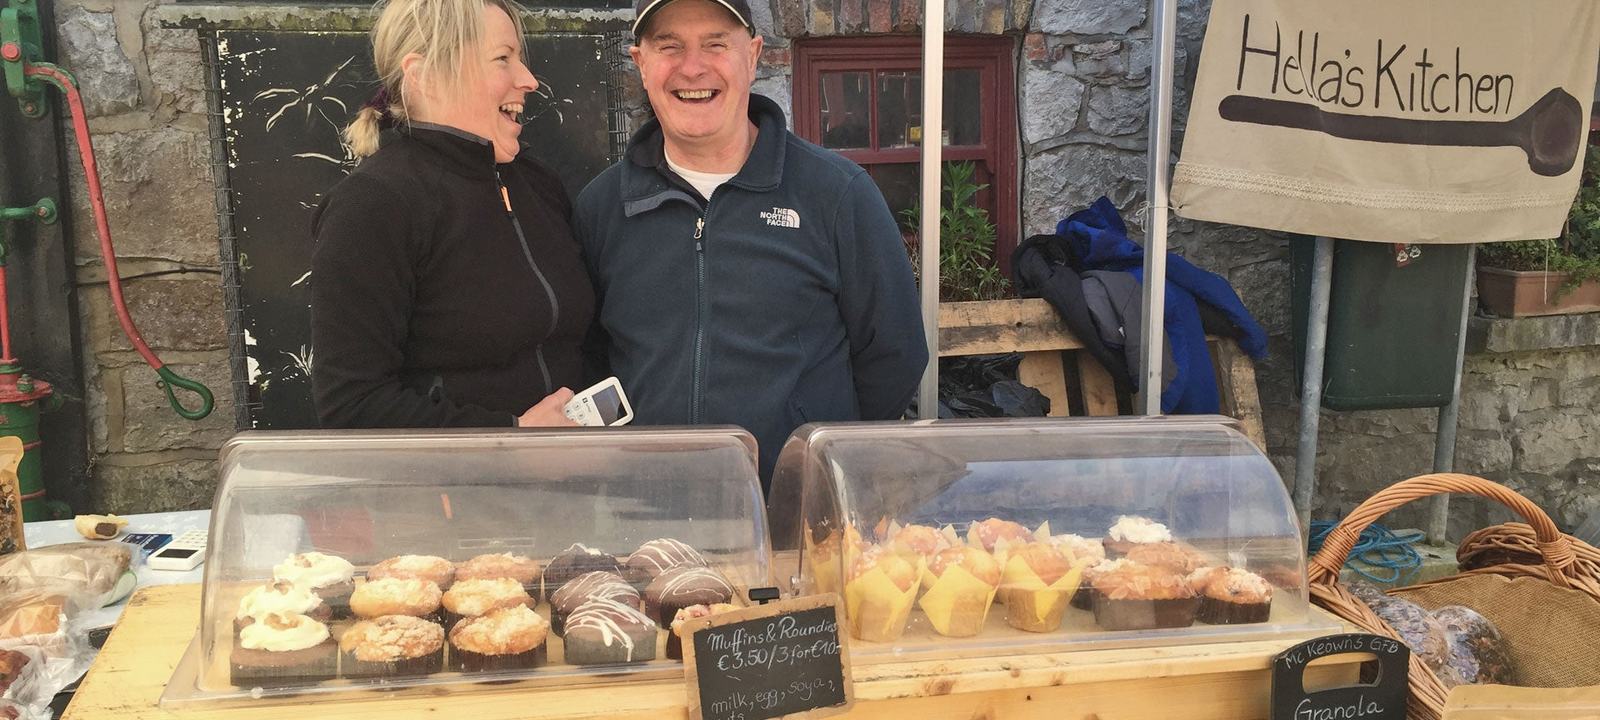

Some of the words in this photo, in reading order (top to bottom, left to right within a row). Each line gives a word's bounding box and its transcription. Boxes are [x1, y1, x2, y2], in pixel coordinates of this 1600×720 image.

[1237, 13, 1364, 108] Hella's
[1375, 38, 1514, 115] Kitchen
[760, 211, 787, 220] NORTH
[766, 218, 786, 227] FACE
[707, 627, 764, 653] Muffins
[778, 616, 837, 638] Roundies
[1294, 694, 1384, 720] Granola
